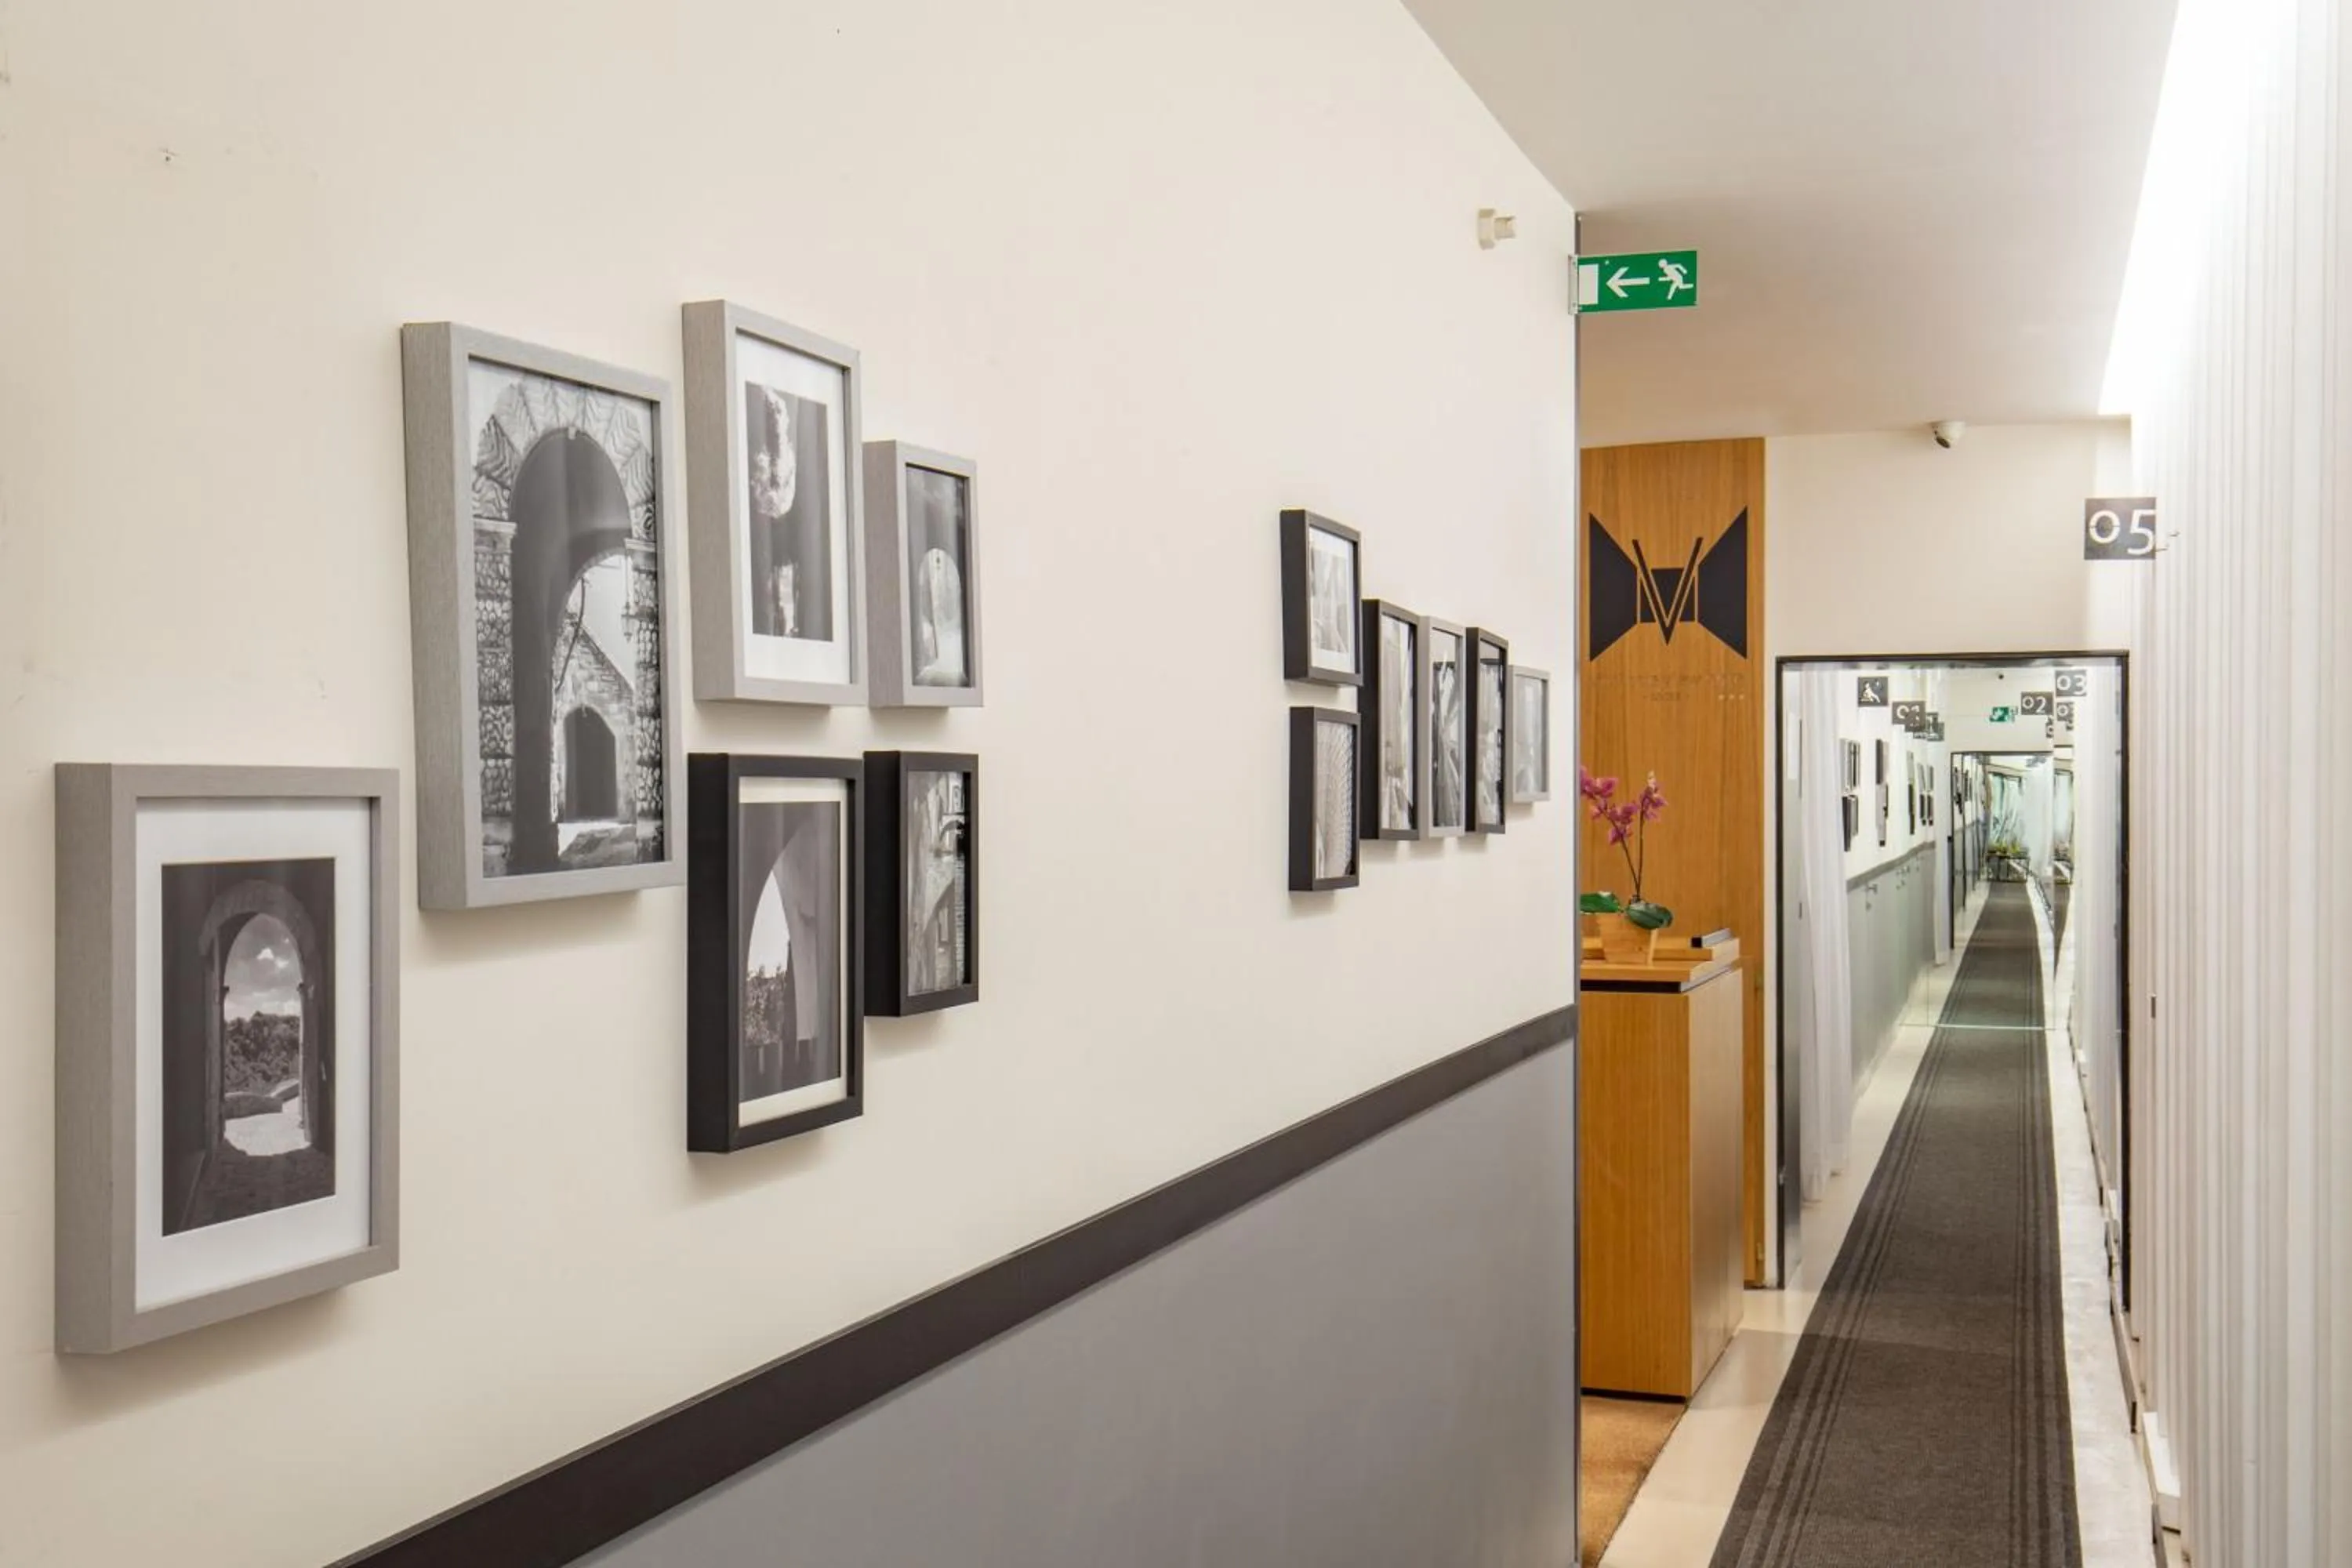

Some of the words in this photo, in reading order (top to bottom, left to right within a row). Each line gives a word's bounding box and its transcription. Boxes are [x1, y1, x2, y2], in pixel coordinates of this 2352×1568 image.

[2089, 509, 2157, 556] 05
[2056, 675, 2087, 695] 03
[2022, 695, 2046, 714] 02
